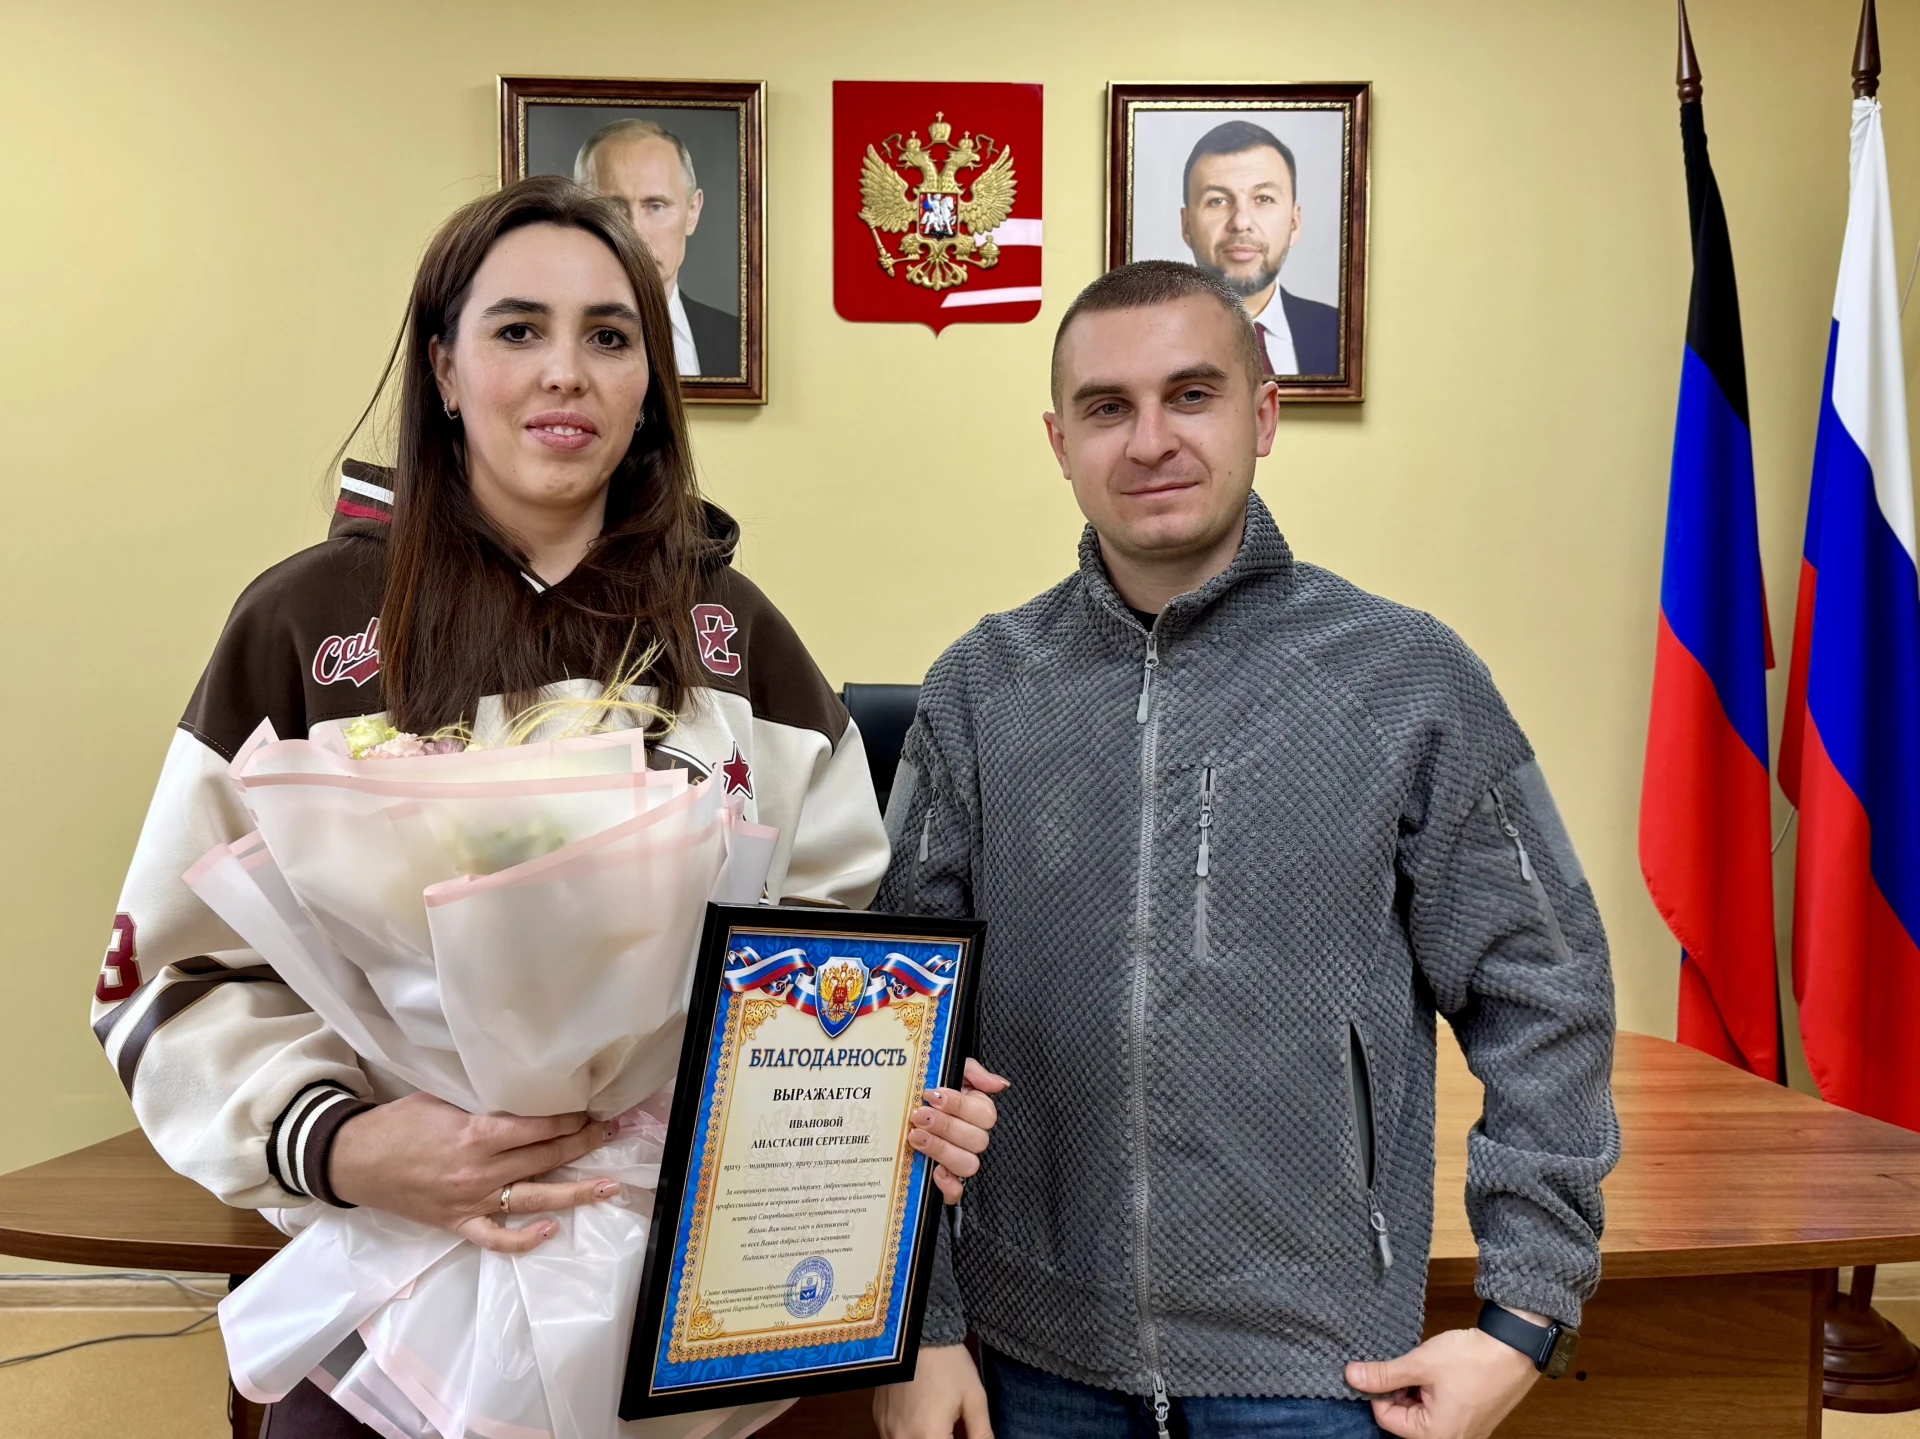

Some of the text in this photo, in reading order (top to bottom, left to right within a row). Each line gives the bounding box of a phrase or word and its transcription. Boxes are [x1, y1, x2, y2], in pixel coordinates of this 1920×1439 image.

[749, 1048, 907, 1070] БЛАГОДАРНОСТЬ
[773, 1087, 871, 1101] ВЫРАЖАЕТСЯ
[789, 1117, 843, 1129] ИВАНОВОЙ
[751, 1135, 870, 1149] АНАСТАСИИ СЕРГЕЕВНЕ
[724, 1164, 741, 1172] врачу
[796, 1160, 812, 1168] врачу
[858, 1156, 893, 1164] диагностики
